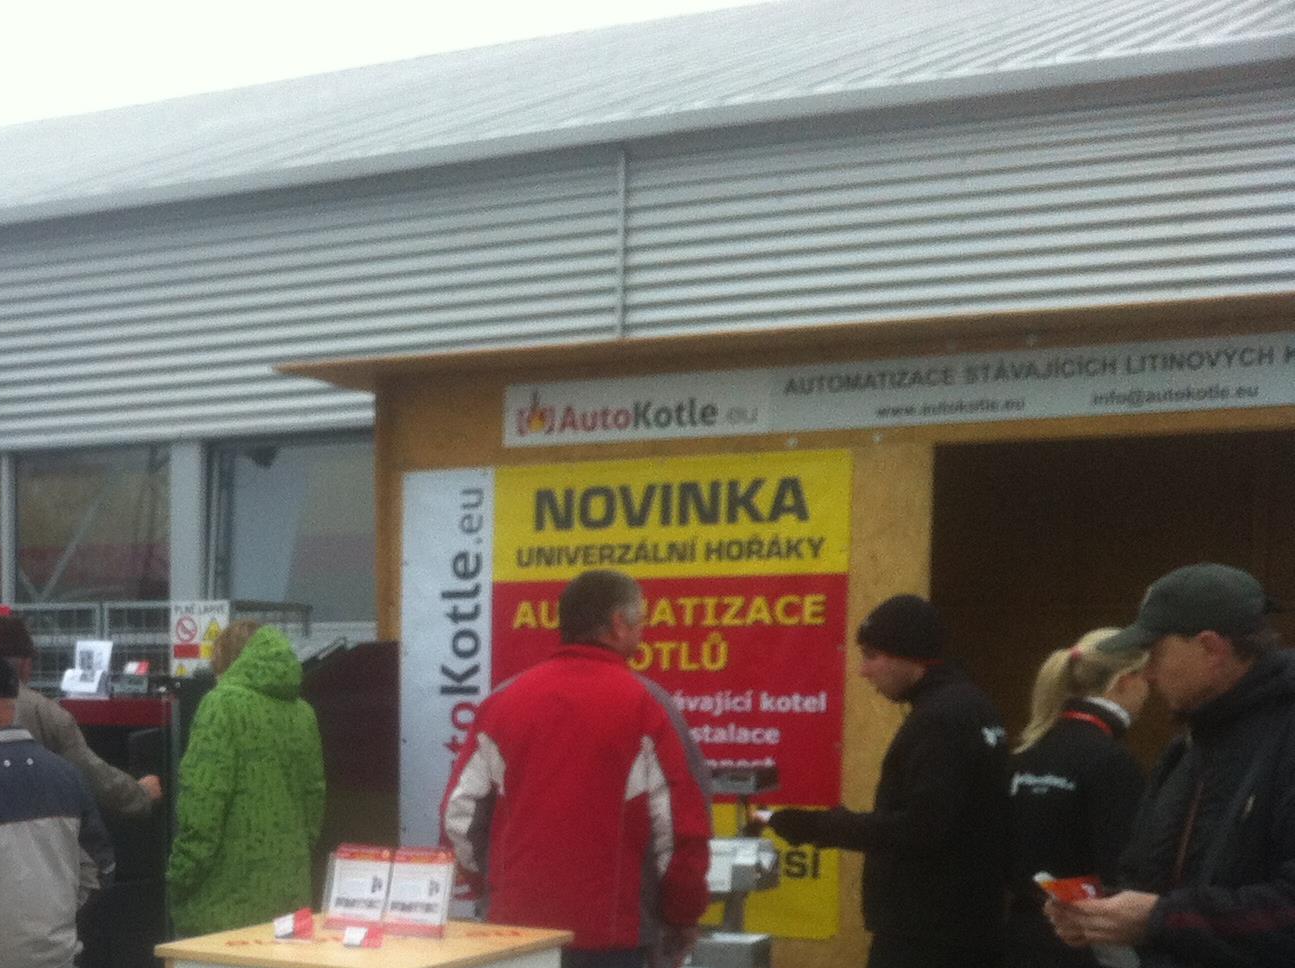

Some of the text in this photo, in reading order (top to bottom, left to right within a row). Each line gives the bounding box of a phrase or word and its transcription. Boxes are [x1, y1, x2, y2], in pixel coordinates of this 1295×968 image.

[782, 366, 954, 396] AUTOMATIZACE
[533, 475, 810, 532] NOVINKA
[515, 534, 826, 568] UNIVERZÁLNÍ HOŘÁKY
[512, 593, 828, 630] AUATIZACE
[625, 631, 729, 672] OTLŮ
[759, 690, 828, 714] kotel
[688, 722, 781, 744] stalace
